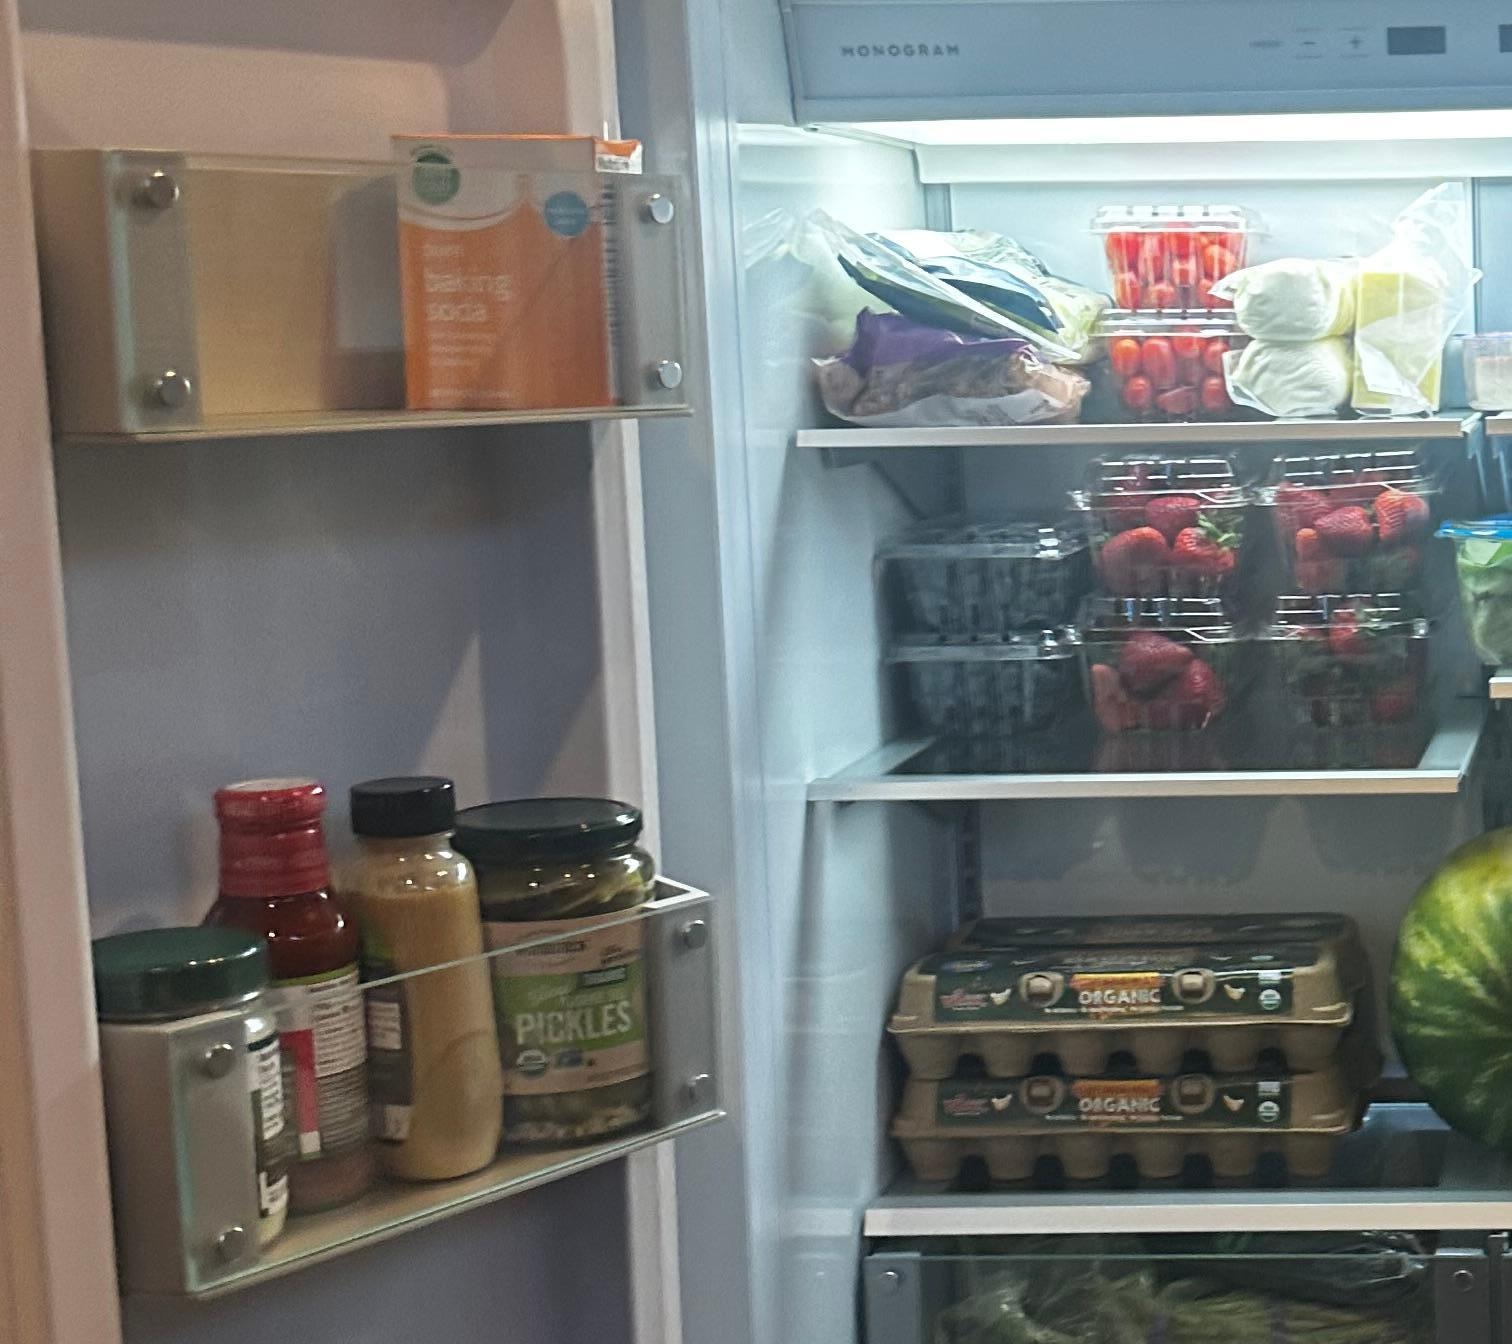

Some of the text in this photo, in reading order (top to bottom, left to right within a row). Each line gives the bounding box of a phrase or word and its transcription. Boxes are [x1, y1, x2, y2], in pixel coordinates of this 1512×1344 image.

[840, 43, 960, 57] MONOGRAM
[1078, 989, 1161, 1006] ORGANIC
[515, 1000, 632, 1045] PICKLES
[1078, 1097, 1161, 1113] ORGANIC
